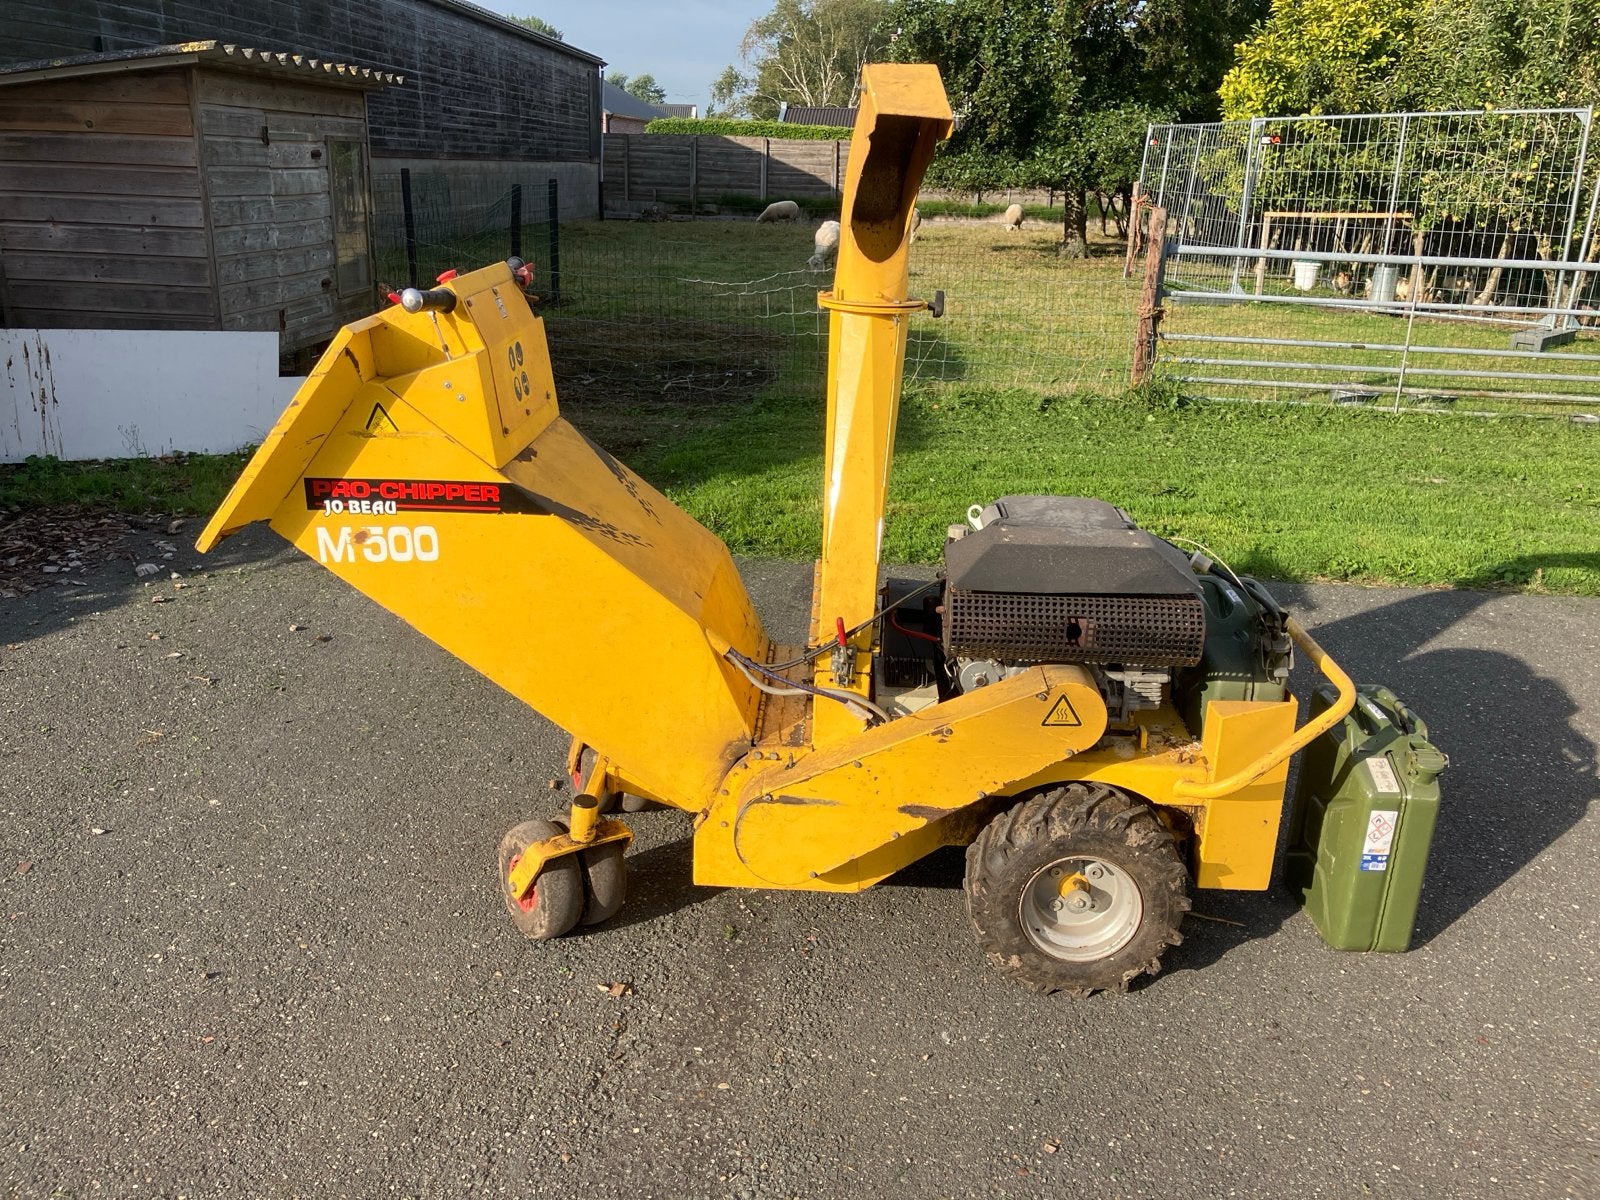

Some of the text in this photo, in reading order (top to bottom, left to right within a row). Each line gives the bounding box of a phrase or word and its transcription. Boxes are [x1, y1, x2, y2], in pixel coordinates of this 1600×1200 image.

[312, 480, 500, 502] PRO-CHIPPER
[323, 499, 397, 517] JO BEAU
[316, 525, 439, 563] M 500
